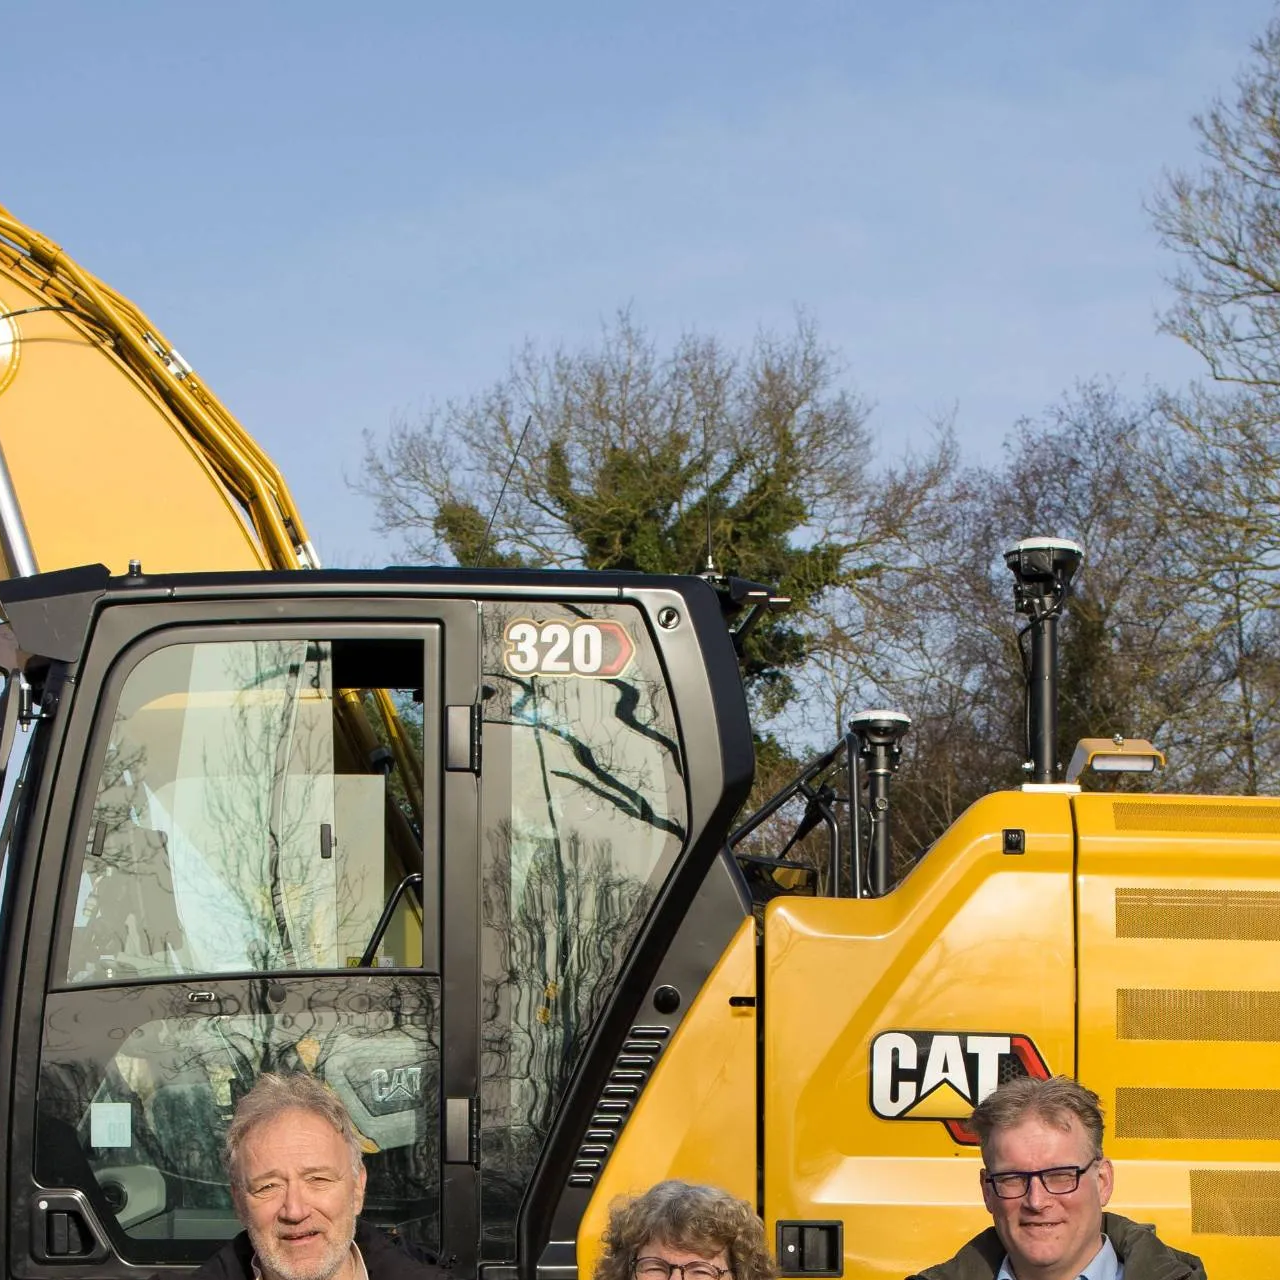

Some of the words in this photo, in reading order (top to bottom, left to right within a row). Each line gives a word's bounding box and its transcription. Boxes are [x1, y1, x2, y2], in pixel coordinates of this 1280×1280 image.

[509, 623, 602, 672] 320
[371, 1068, 421, 1102] CAT
[872, 1032, 1011, 1117] CAT
